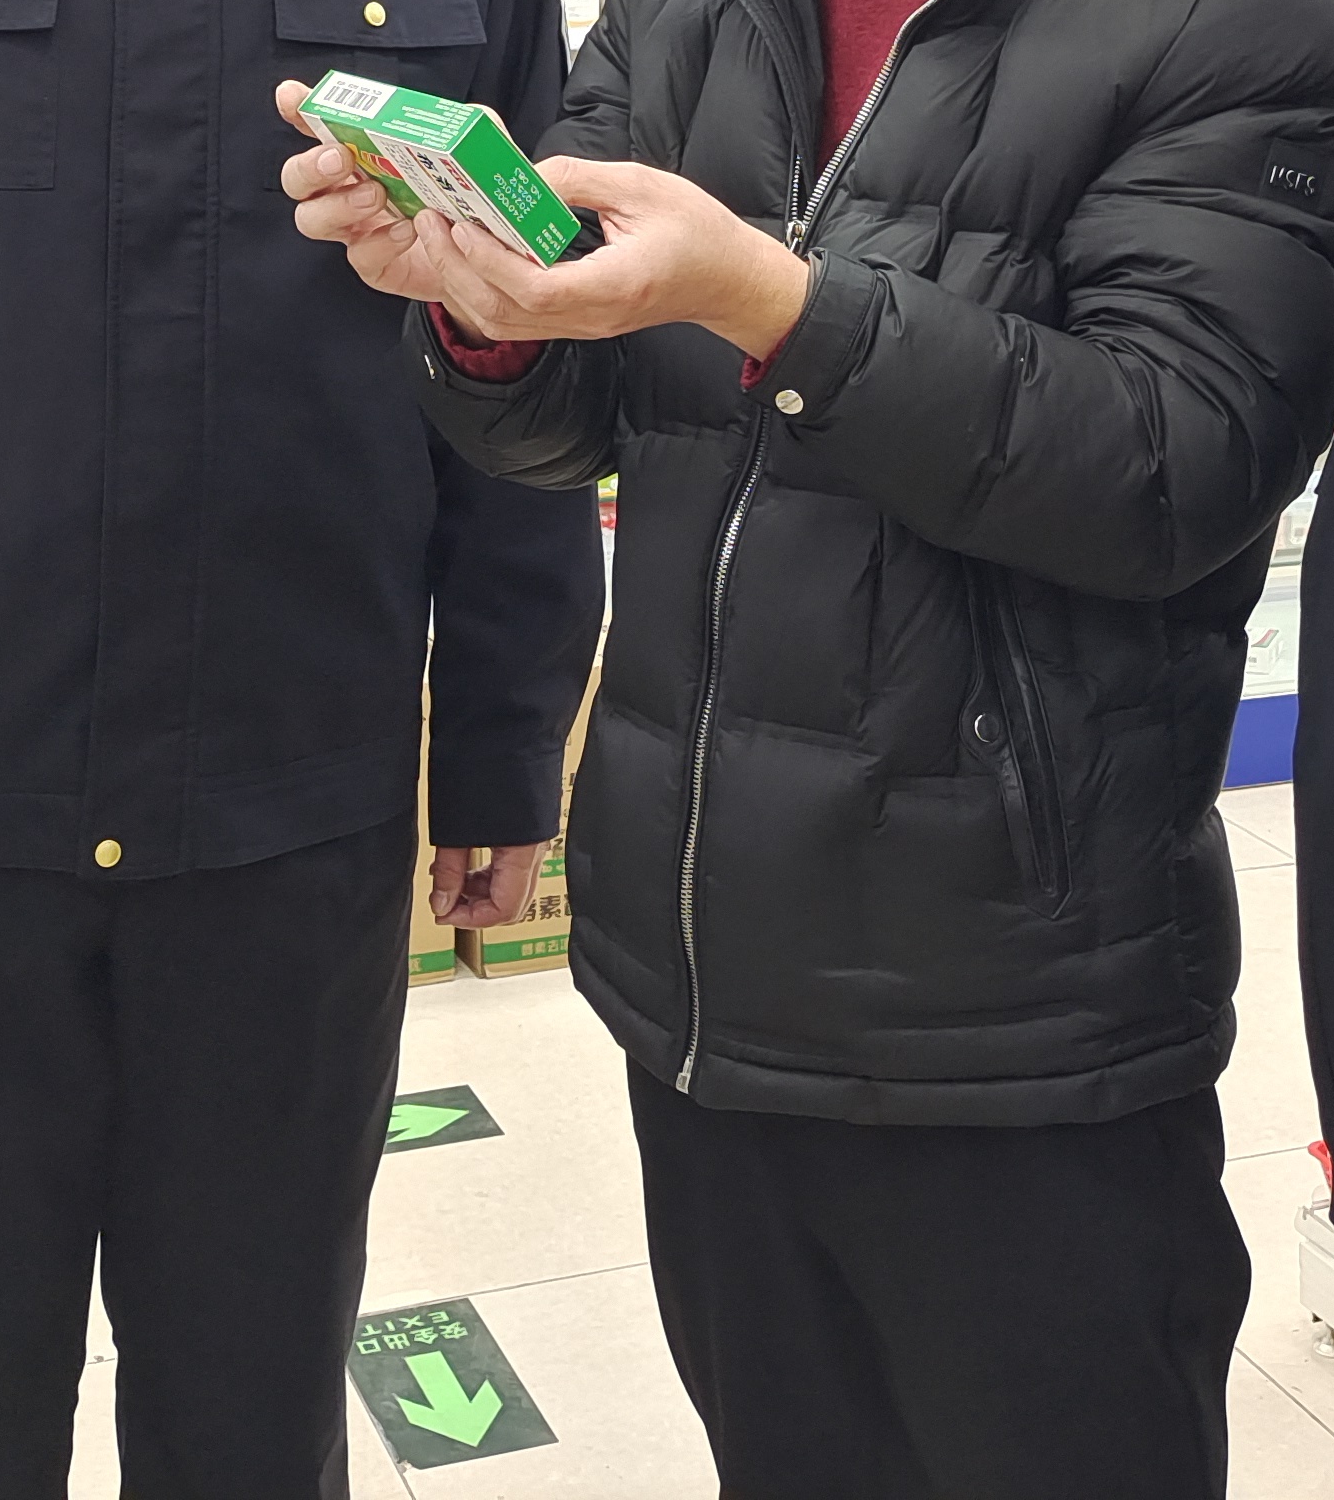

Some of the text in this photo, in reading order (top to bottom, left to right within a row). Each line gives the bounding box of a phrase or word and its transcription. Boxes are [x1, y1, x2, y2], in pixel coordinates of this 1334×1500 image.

[356, 1321, 469, 1356] 安全出口
[360, 1310, 450, 1337] EXIT
